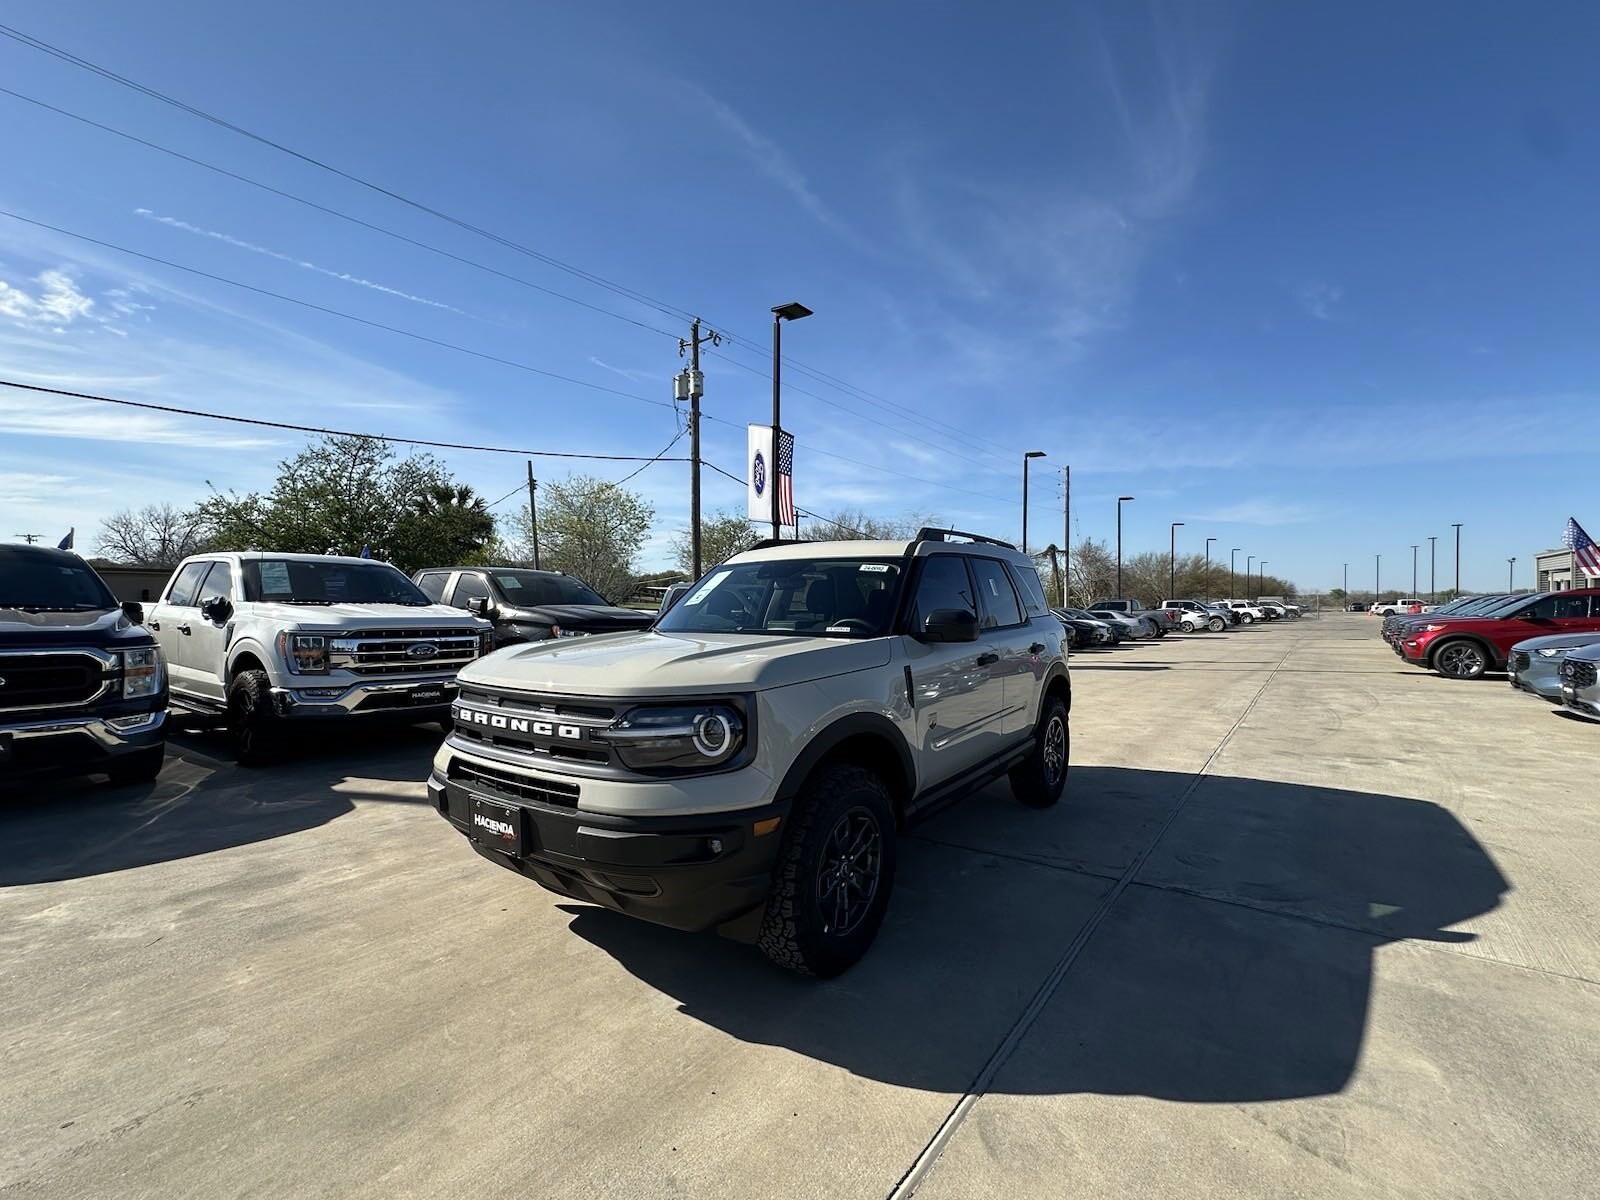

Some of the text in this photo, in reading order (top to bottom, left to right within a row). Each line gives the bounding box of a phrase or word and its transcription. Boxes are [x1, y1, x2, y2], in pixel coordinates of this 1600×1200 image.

[755, 459, 764, 488] Ford
[459, 709, 580, 739] BRONCO
[474, 813, 514, 837] HACIENDA
